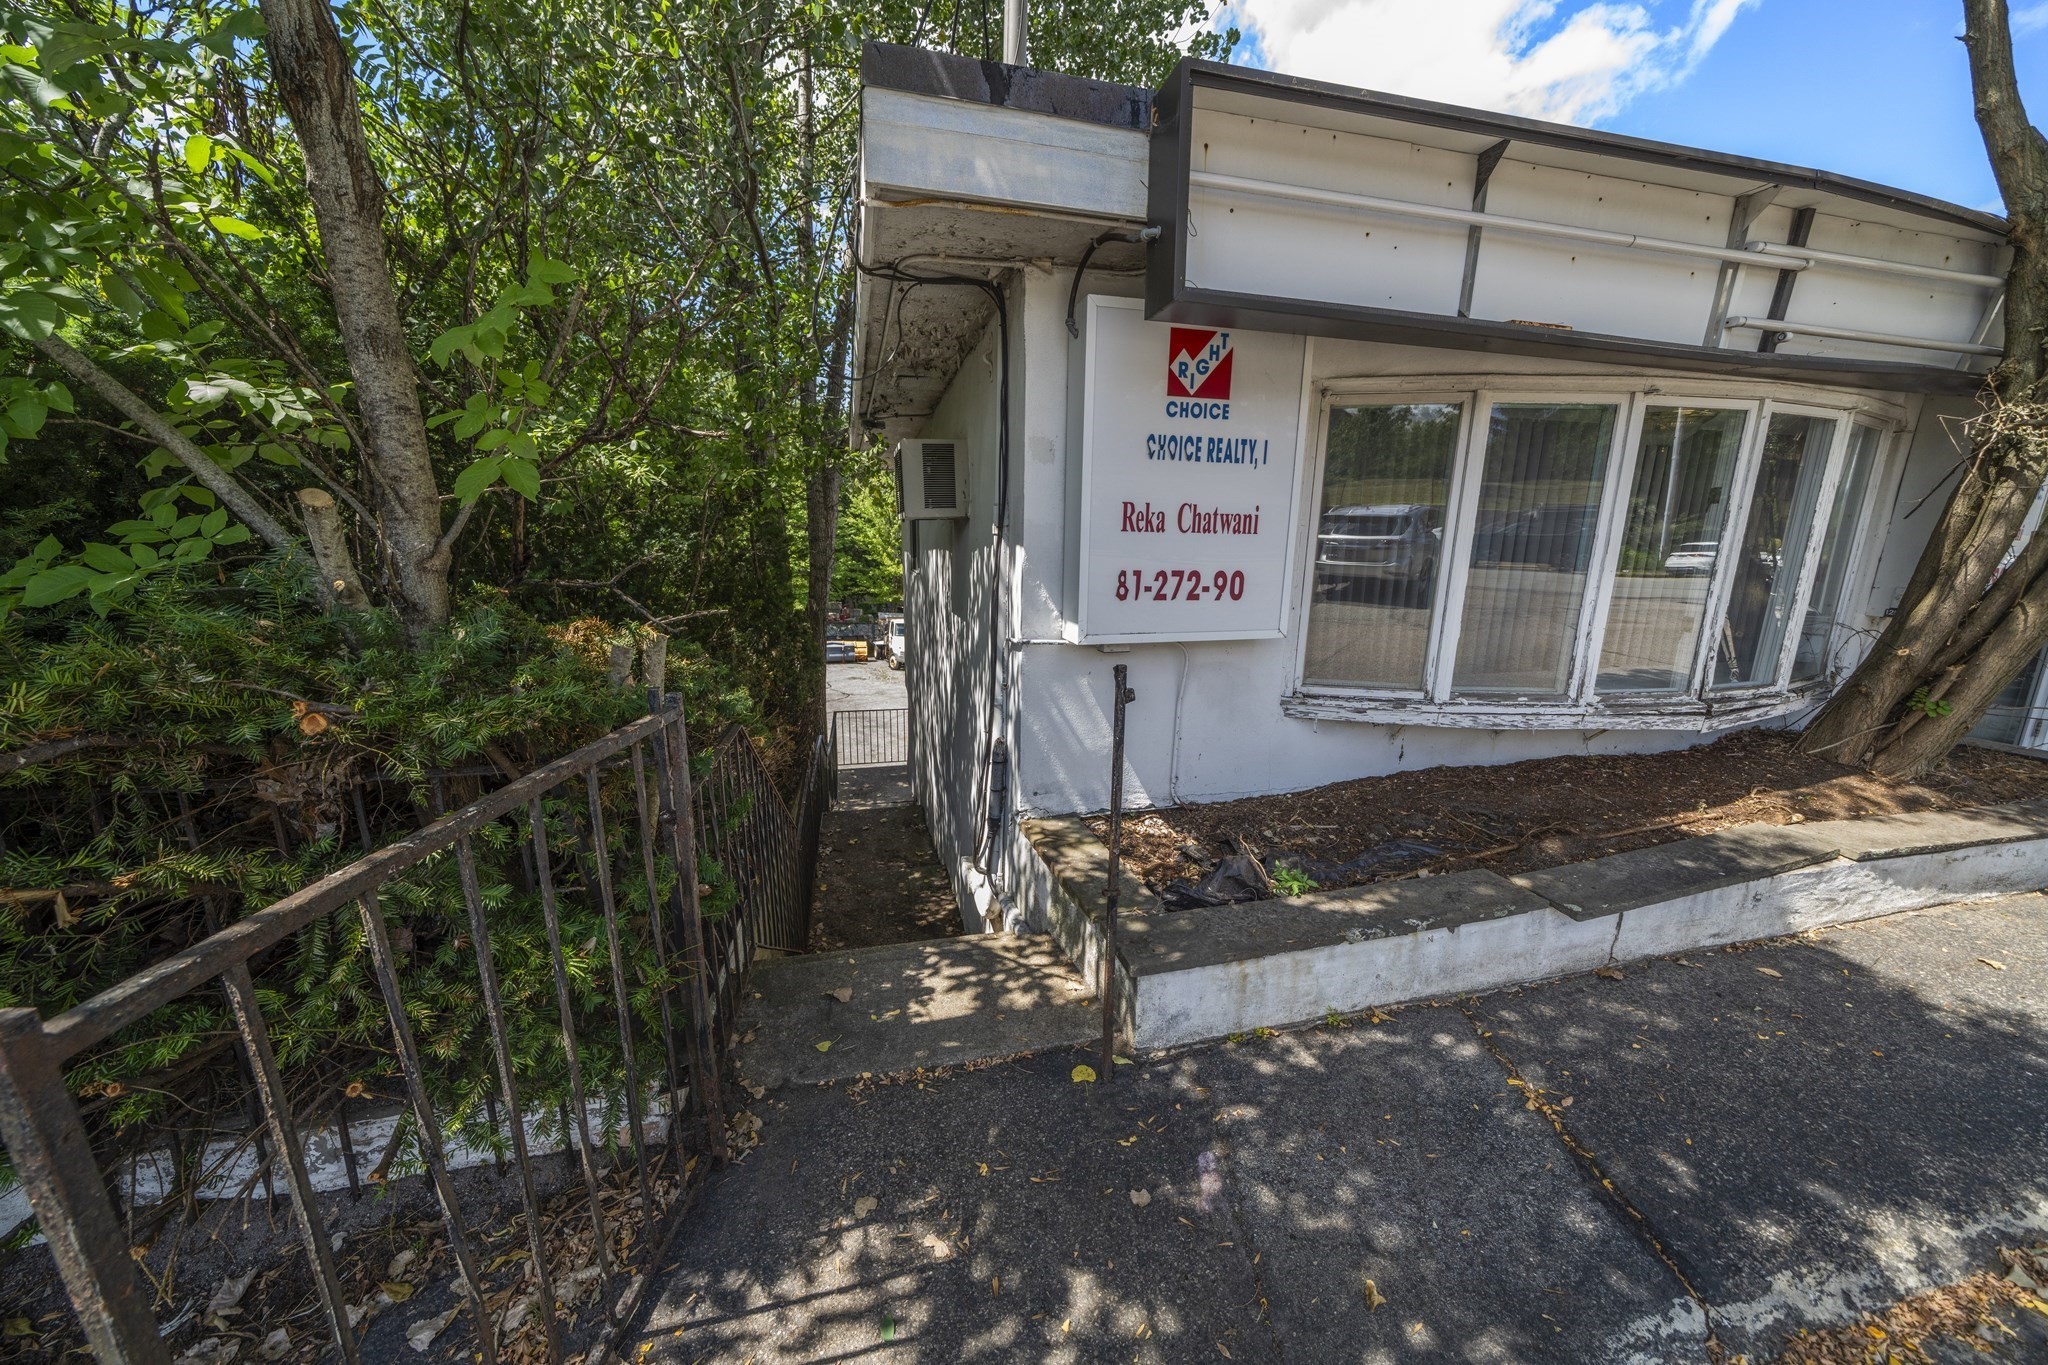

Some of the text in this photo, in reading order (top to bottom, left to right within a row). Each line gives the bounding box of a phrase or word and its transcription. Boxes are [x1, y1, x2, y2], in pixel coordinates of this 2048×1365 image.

[1178, 332, 1230, 390] RIGHT
[1166, 401, 1230, 420] CHOICE
[1147, 433, 1202, 463] CHOICE
[1206, 437, 1258, 469] REALTY,
[1121, 501, 1260, 535] Reka Chatwani
[1115, 570, 1245, 601] 81-272-90
